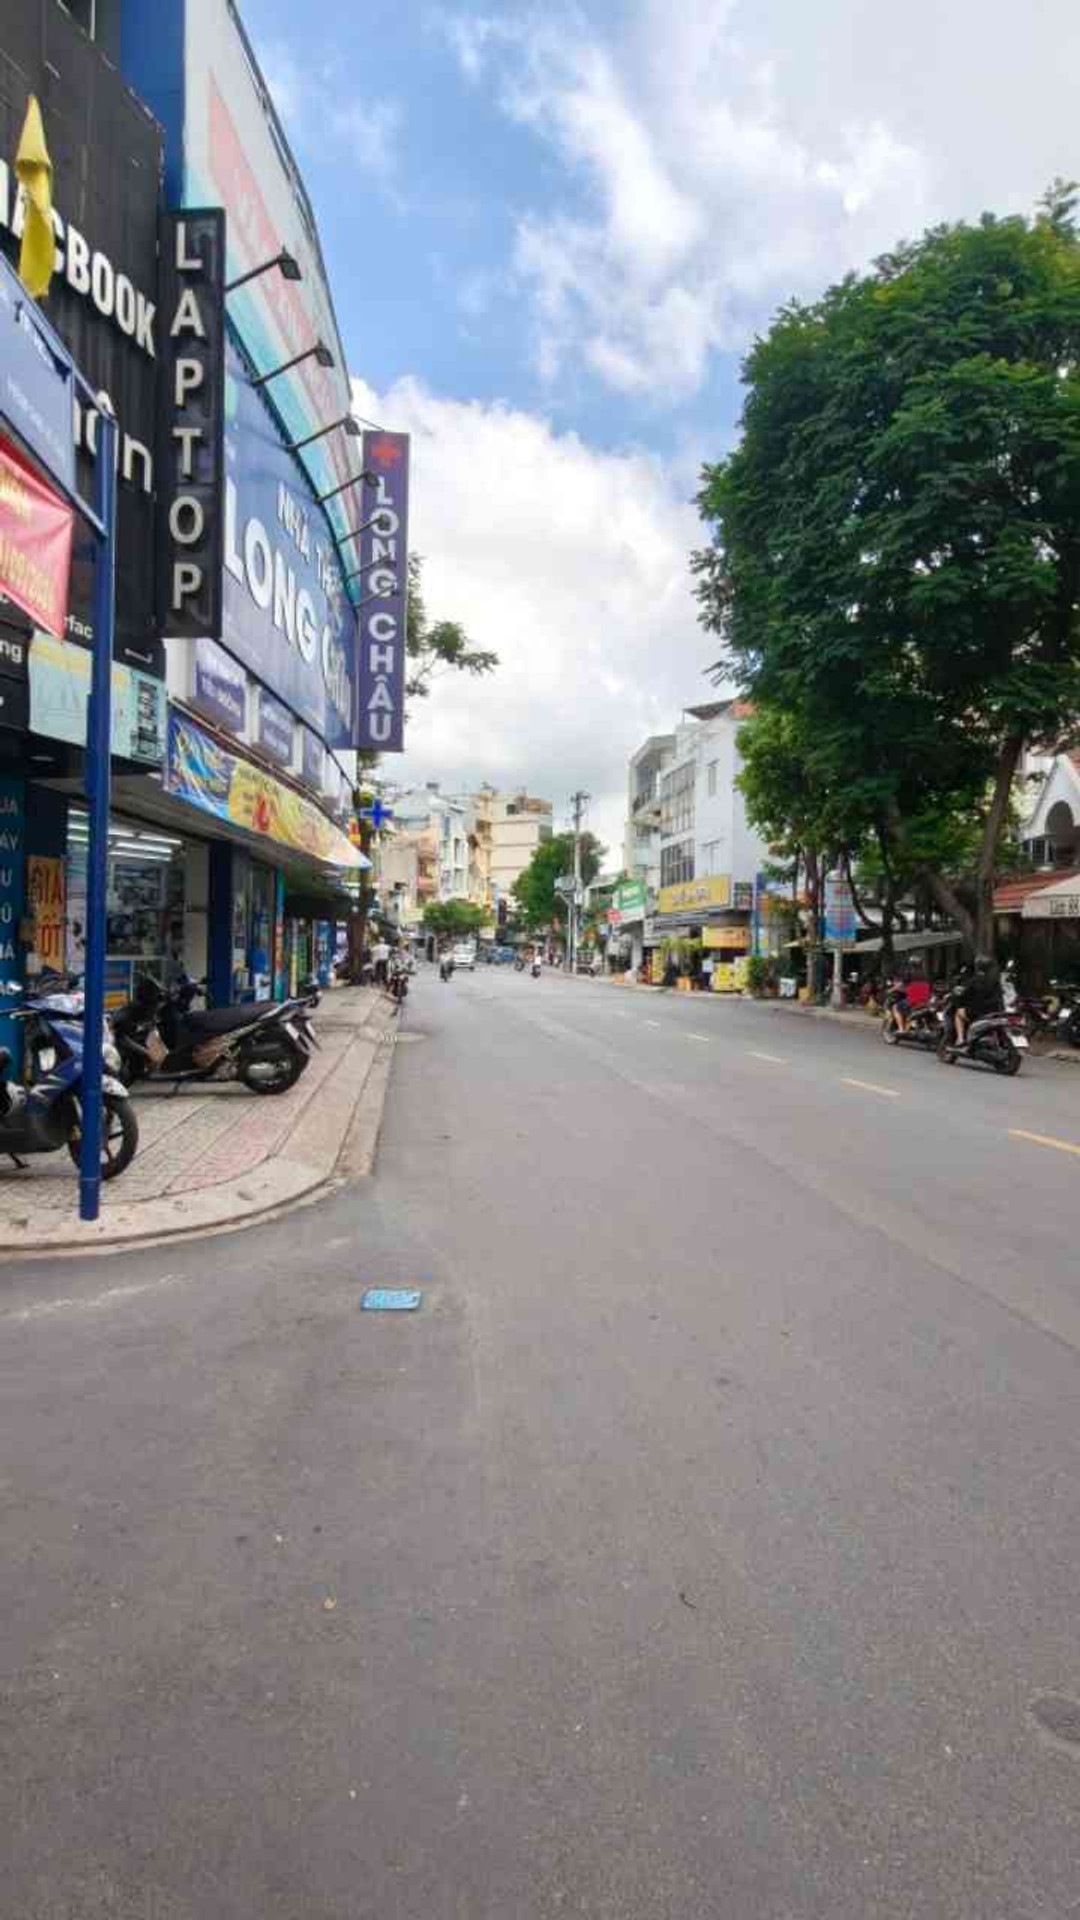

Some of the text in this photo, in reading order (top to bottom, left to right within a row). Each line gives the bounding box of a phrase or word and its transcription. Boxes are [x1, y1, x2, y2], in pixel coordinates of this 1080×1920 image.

[169, 221, 205, 610] LAPTOP
[224, 478, 318, 665] LONG
[367, 476, 399, 742] LONG CHÂU
